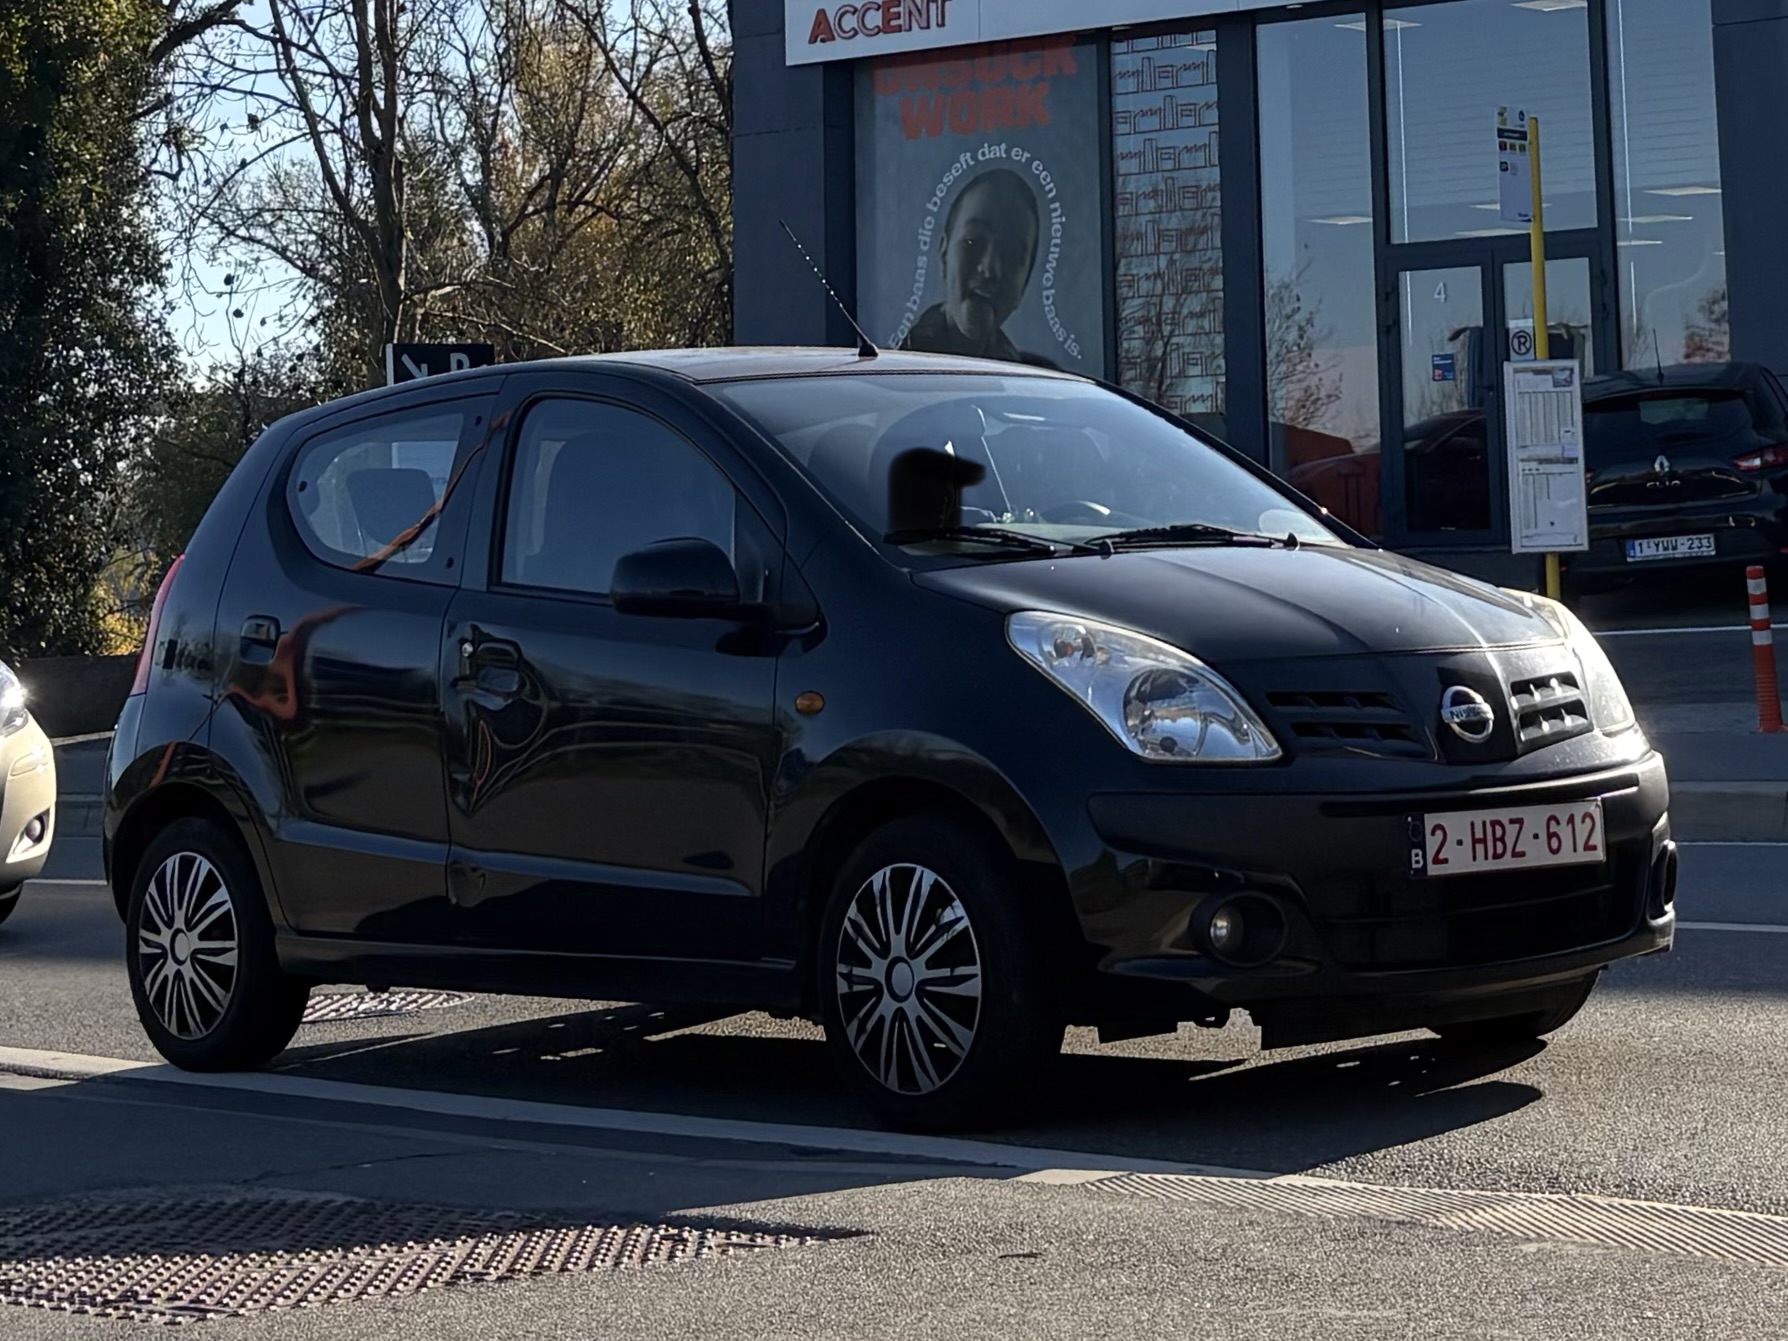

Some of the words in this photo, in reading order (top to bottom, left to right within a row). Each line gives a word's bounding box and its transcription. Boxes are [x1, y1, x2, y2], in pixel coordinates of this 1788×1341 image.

[808, 0, 950, 44] ACCENT
[899, 81, 1050, 140] WORK
[977, 142, 1007, 161] dat
[1010, 147, 1031, 163] er
[926, 151, 975, 212] beseft
[1031, 160, 1058, 199] een
[1434, 281, 1447, 302] 4
[1042, 289, 1067, 342] baas
[1063, 333, 1083, 360] is.
[1411, 849, 1424, 868] B
